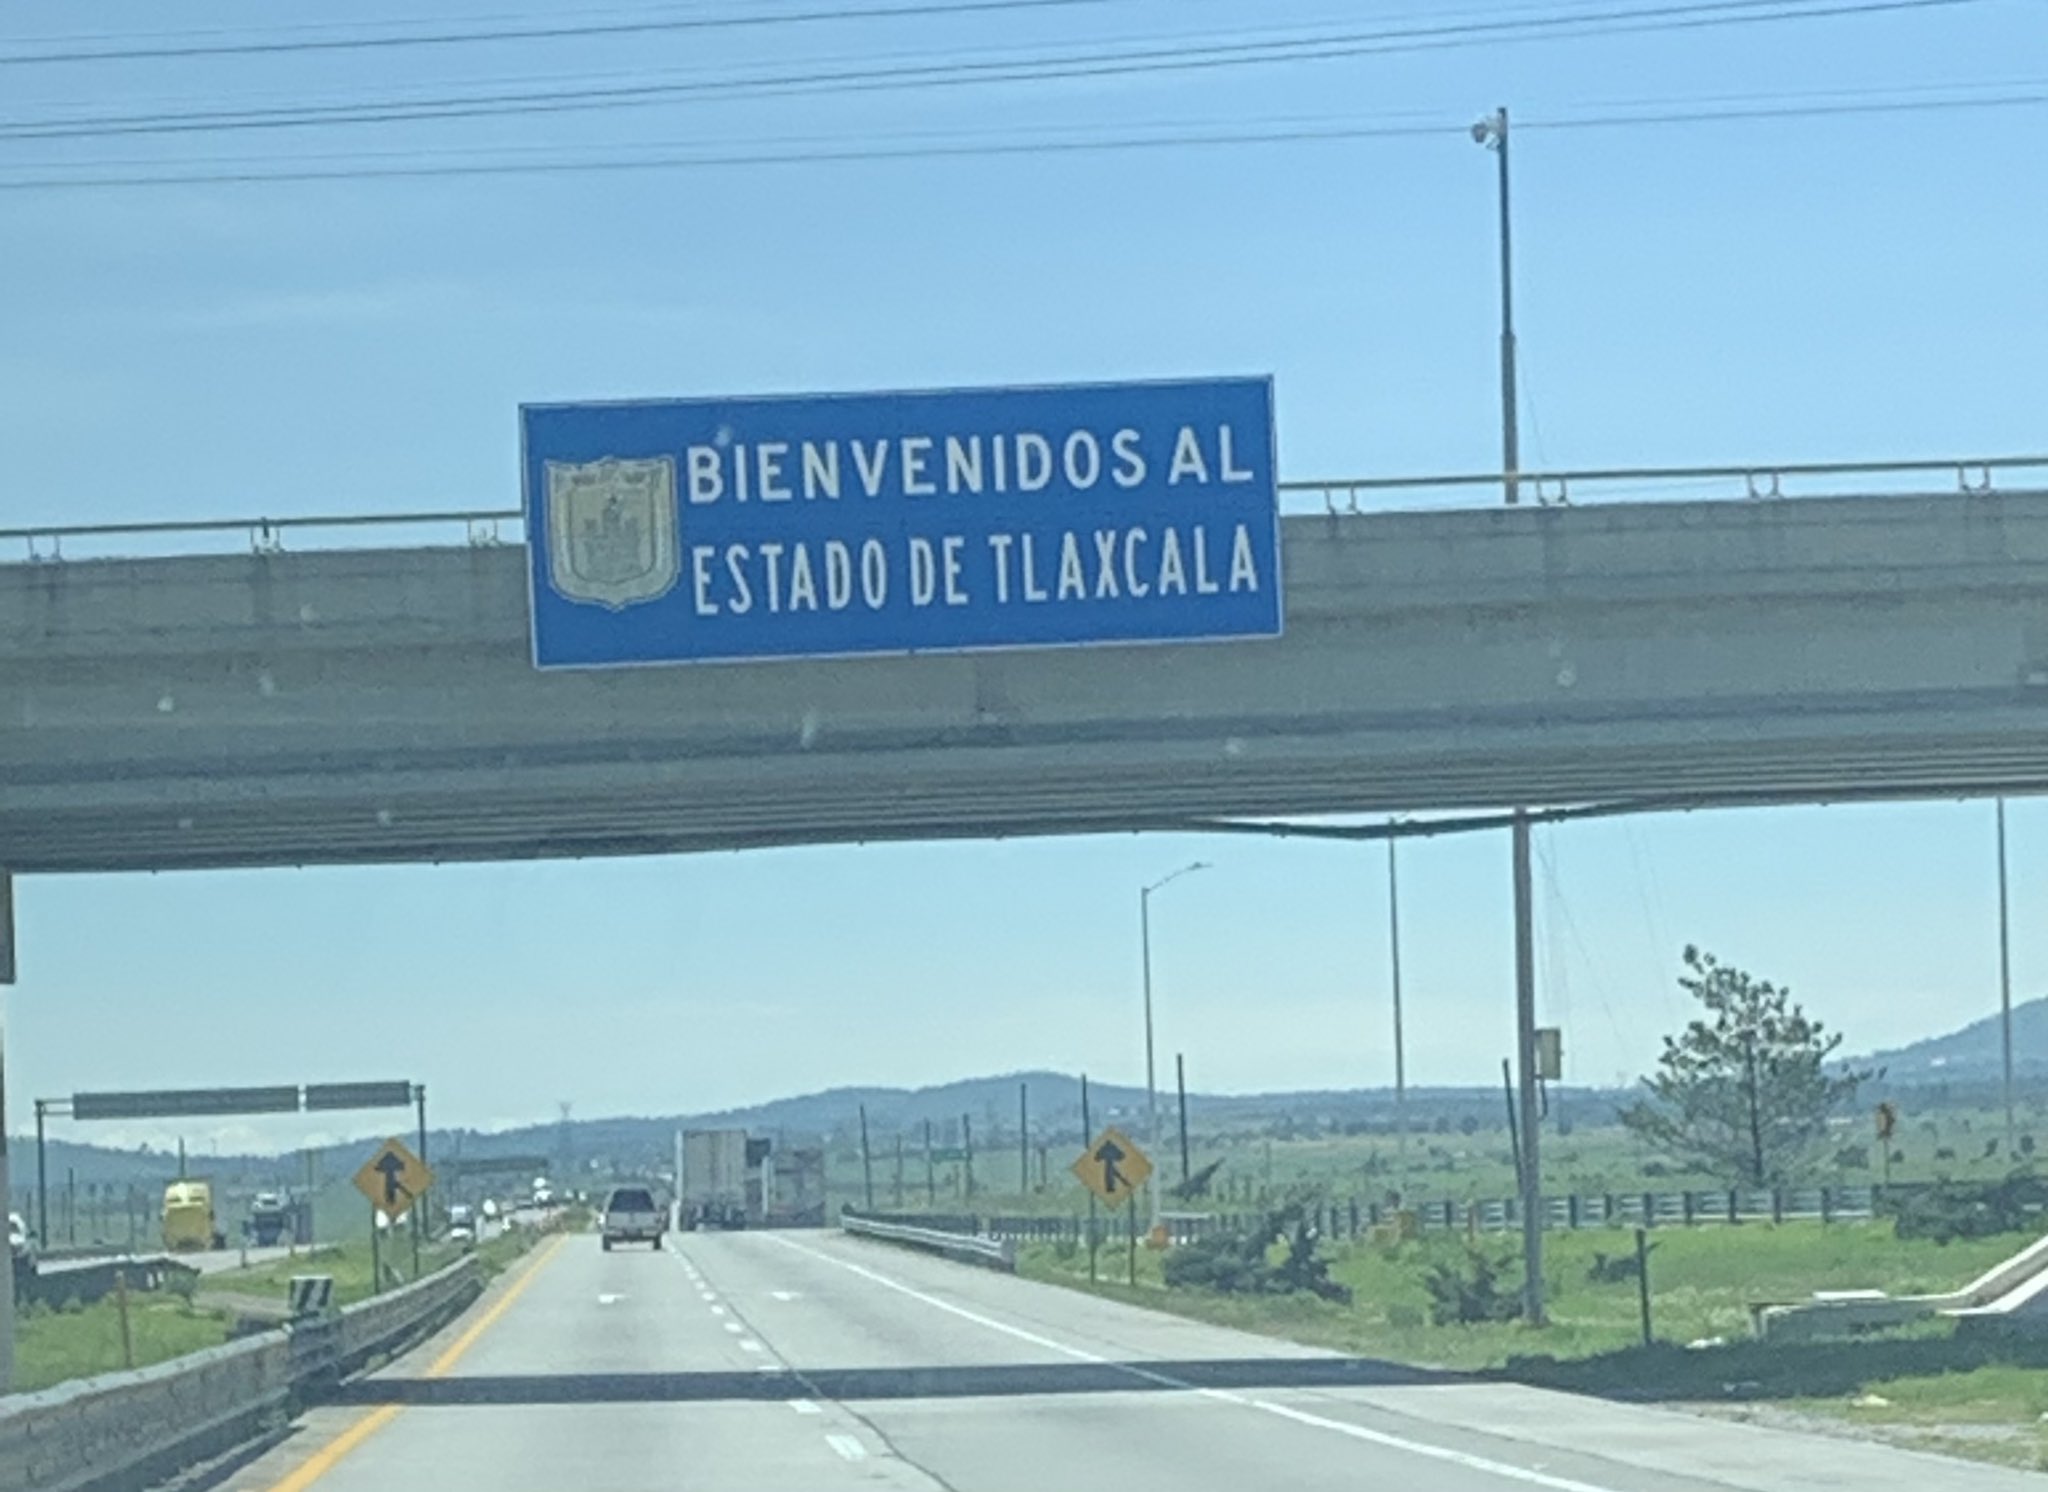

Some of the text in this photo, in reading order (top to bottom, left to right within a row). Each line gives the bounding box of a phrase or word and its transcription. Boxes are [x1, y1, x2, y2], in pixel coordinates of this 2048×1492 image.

[687, 424, 1254, 502] BIENVENIDOS AL
[694, 525, 1259, 615] ESTADO DE TLAXCALA
